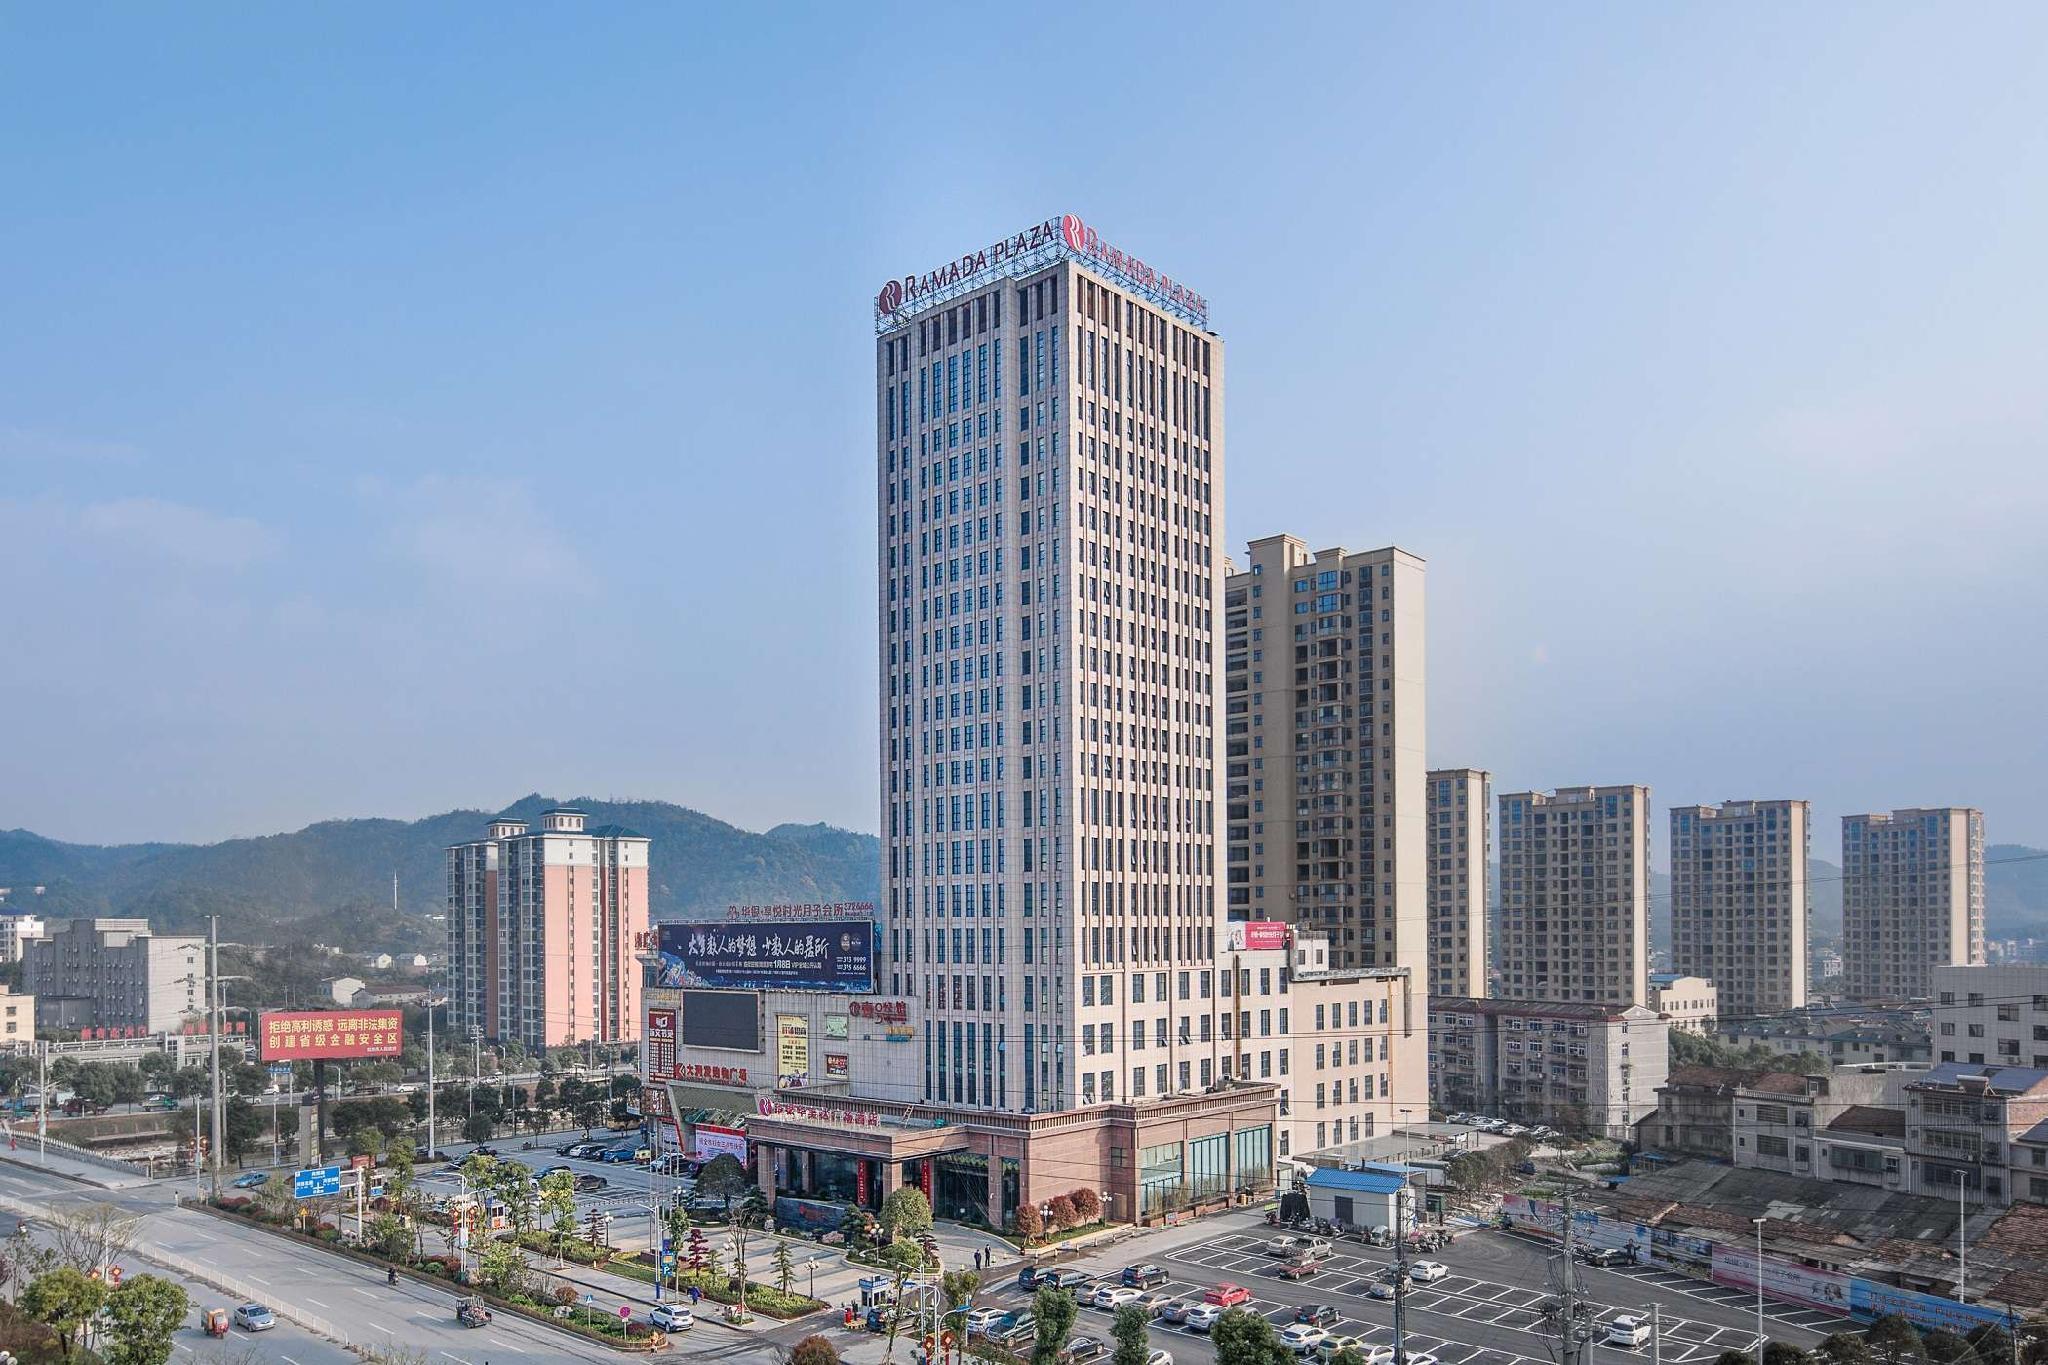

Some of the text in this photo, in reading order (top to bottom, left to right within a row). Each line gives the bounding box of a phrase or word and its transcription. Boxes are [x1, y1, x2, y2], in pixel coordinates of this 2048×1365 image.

[905, 220, 1055, 302] RAMADA PLAZA
[1086, 226, 1157, 290] RAMADA
[268, 1017, 398, 1034] 拒绝高利诱惑 远离非法集资
[269, 1033, 398, 1049] 创建省级金融安全区
